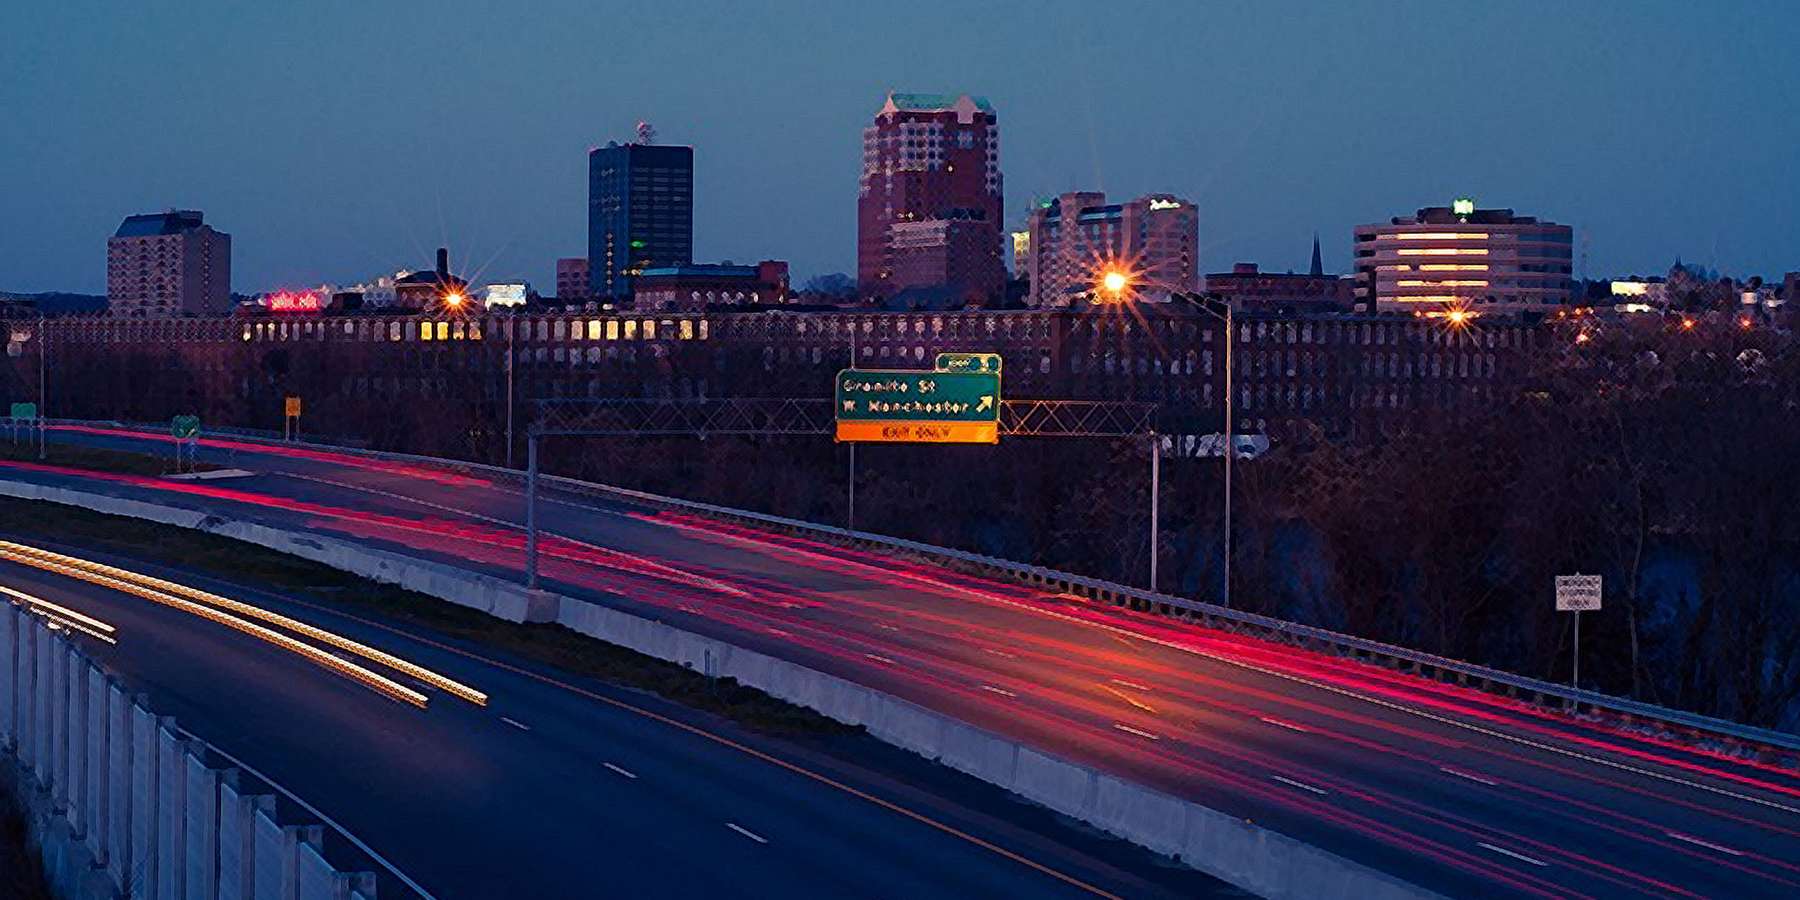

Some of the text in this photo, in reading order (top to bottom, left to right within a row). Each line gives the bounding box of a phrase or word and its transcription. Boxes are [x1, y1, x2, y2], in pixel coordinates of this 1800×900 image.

[843, 379, 936, 393] Granite St
[868, 400, 969, 413] Manchester
